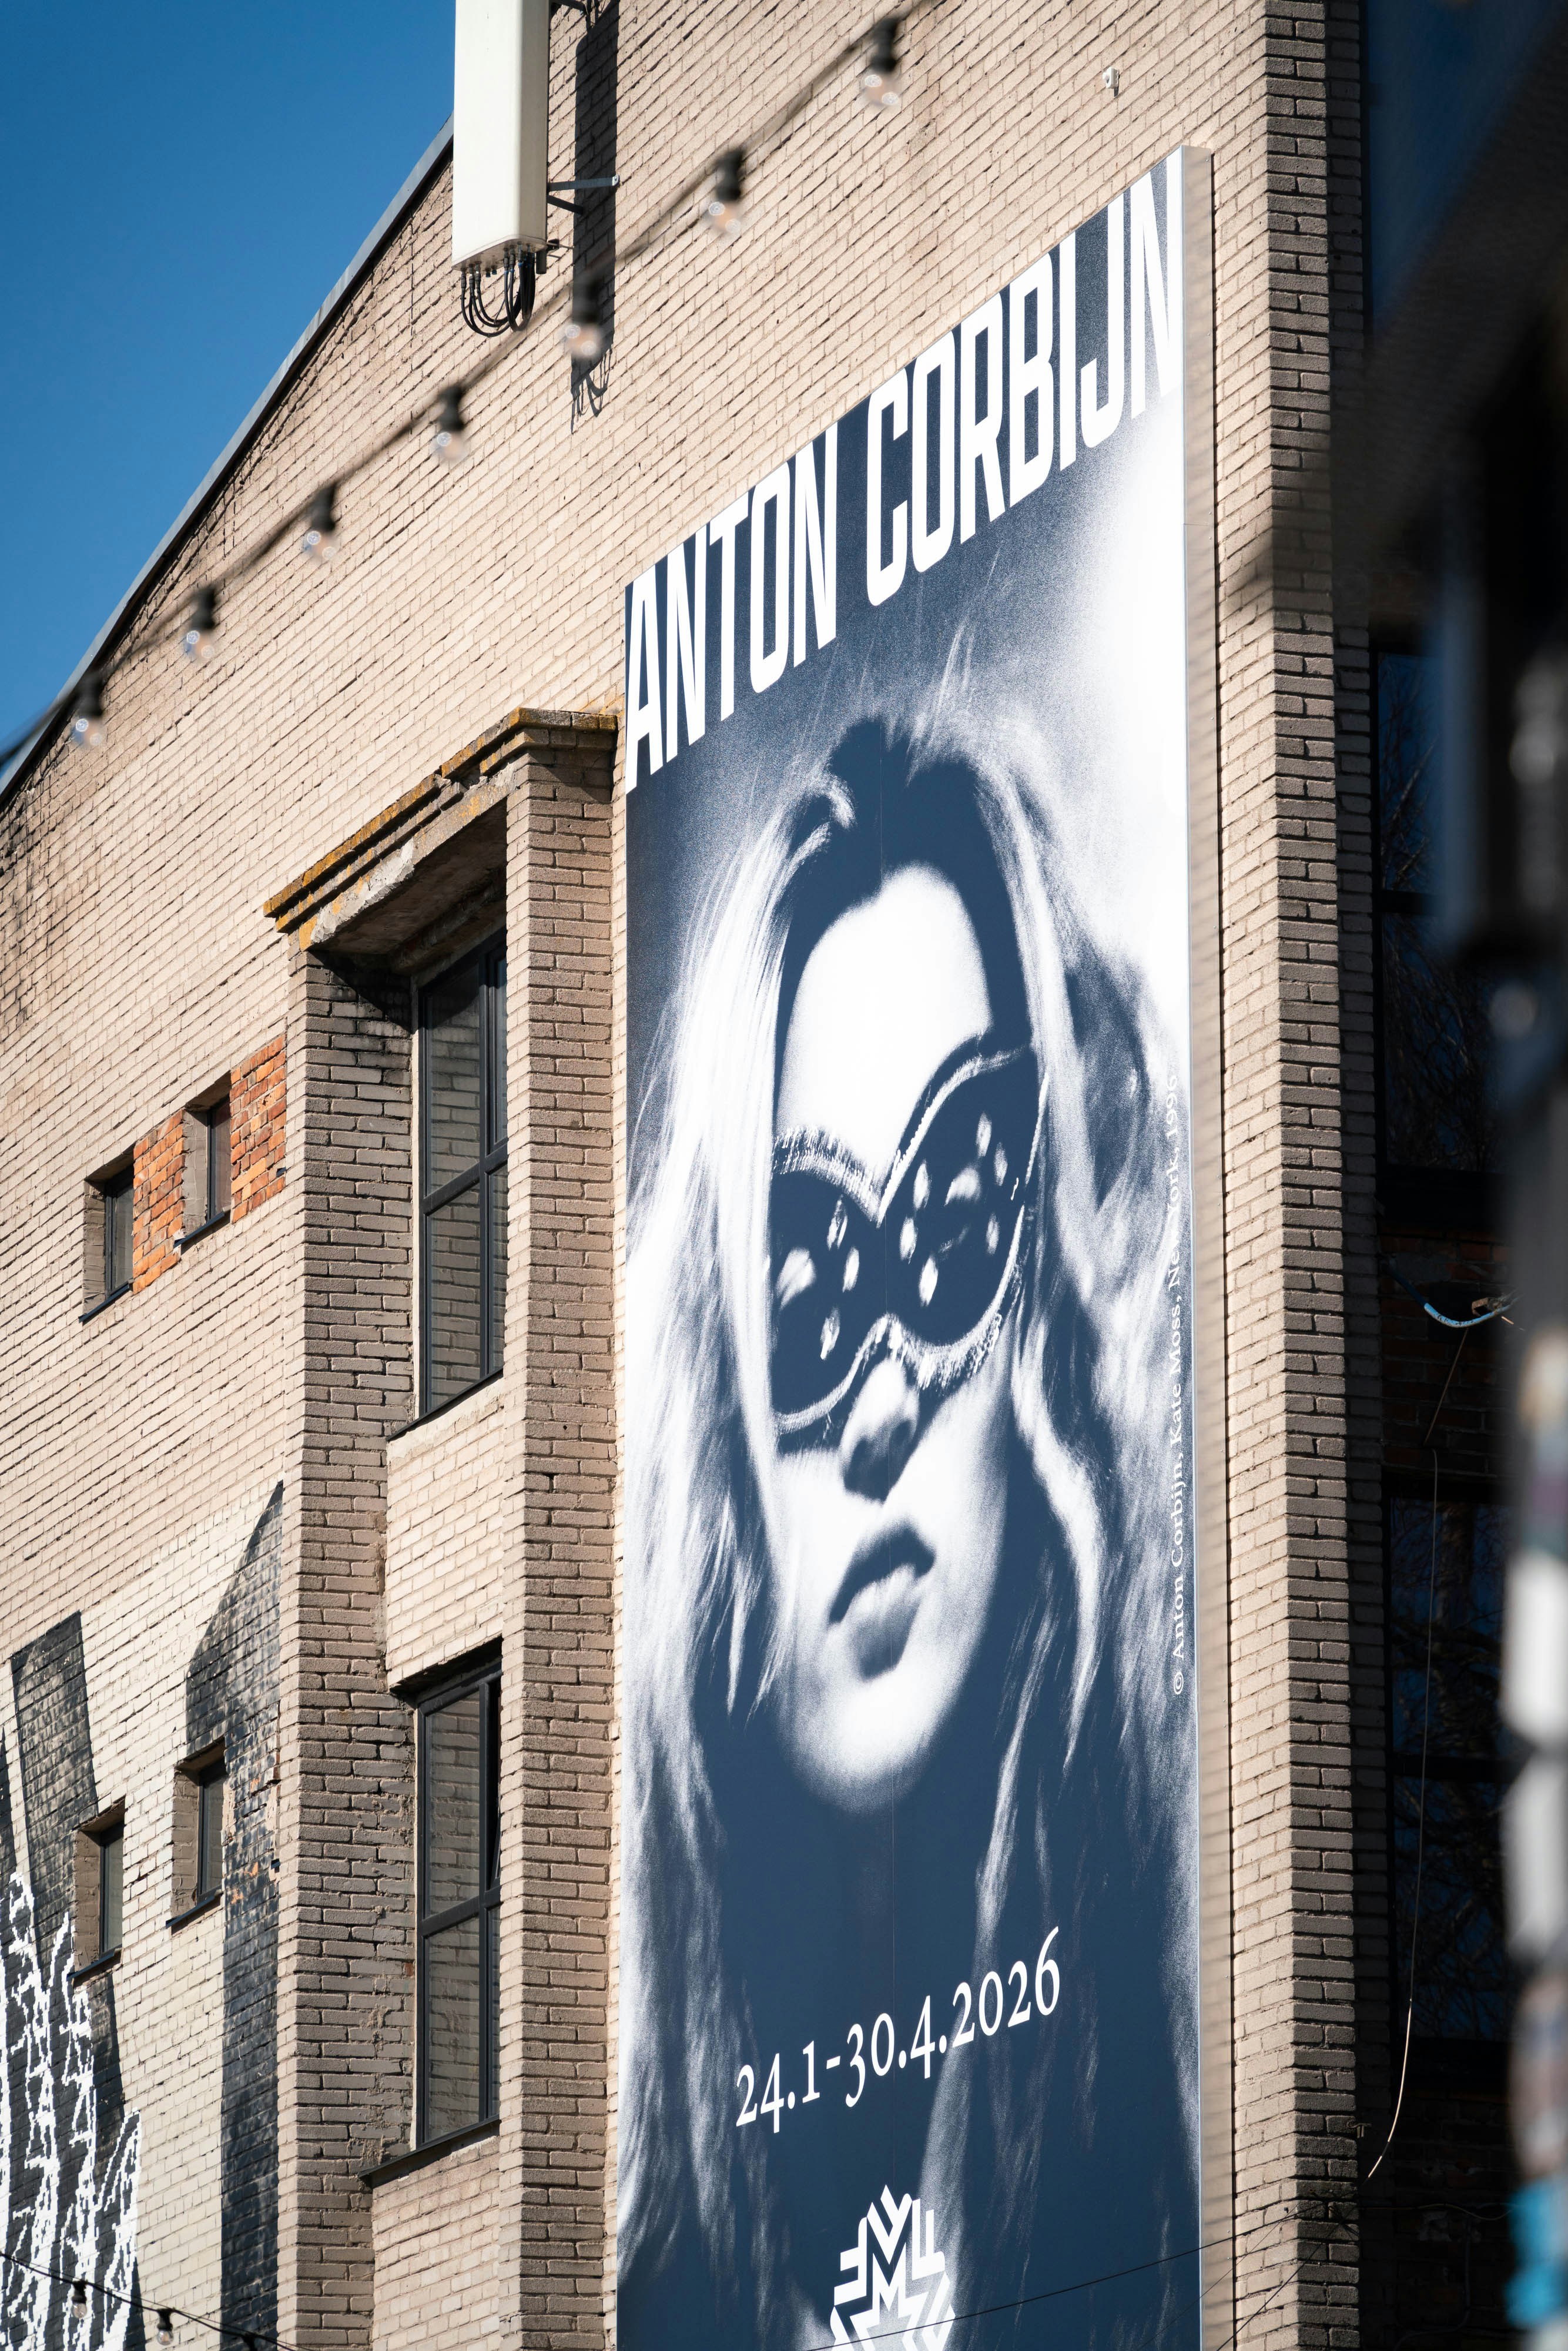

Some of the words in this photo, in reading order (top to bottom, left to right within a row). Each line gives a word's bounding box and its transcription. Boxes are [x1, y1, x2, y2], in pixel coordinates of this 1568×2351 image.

[626, 421, 838, 794] ANTON
[866, 147, 1182, 606] CORBIJN
[1165, 1076, 1178, 1140] 1996
[1166, 1147, 1180, 1223] York,
[1169, 1296, 1182, 1377] Moss,
[1170, 1384, 1182, 1448] Kate
[1171, 1453, 1186, 1567] Corbijn,
[1172, 1575, 1184, 1660] Anton
[736, 1926, 1060, 2134] 24.1-30.4.2026
